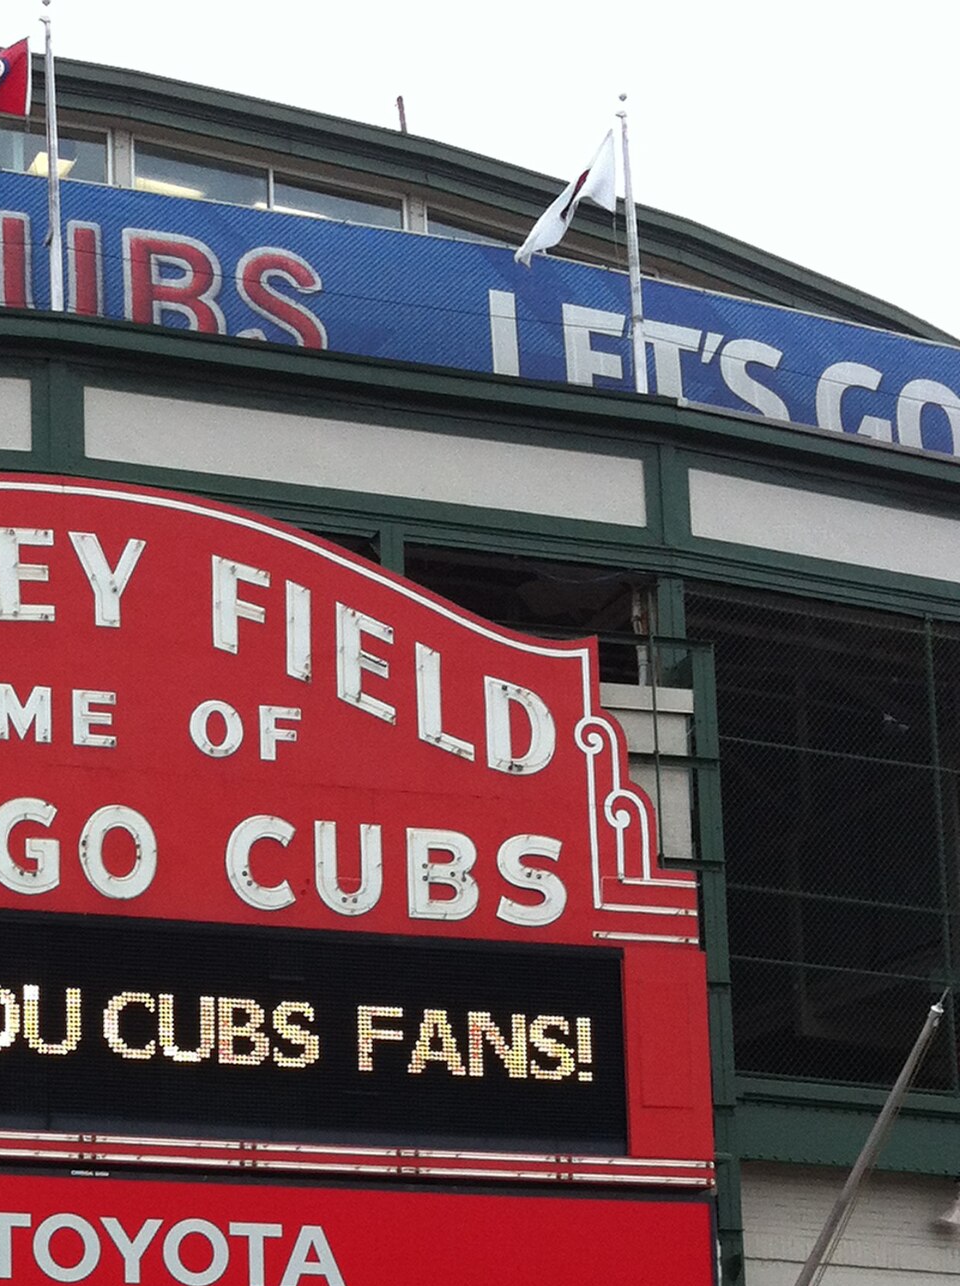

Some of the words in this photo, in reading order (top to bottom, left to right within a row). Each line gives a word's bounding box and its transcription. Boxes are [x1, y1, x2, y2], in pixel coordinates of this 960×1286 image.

[211, 554, 557, 776] FIELD
[189, 699, 302, 762] OF
[225, 815, 567, 927] CUBS
[103, 991, 320, 1068] CUBS
[357, 1005, 593, 1082] FANS!
